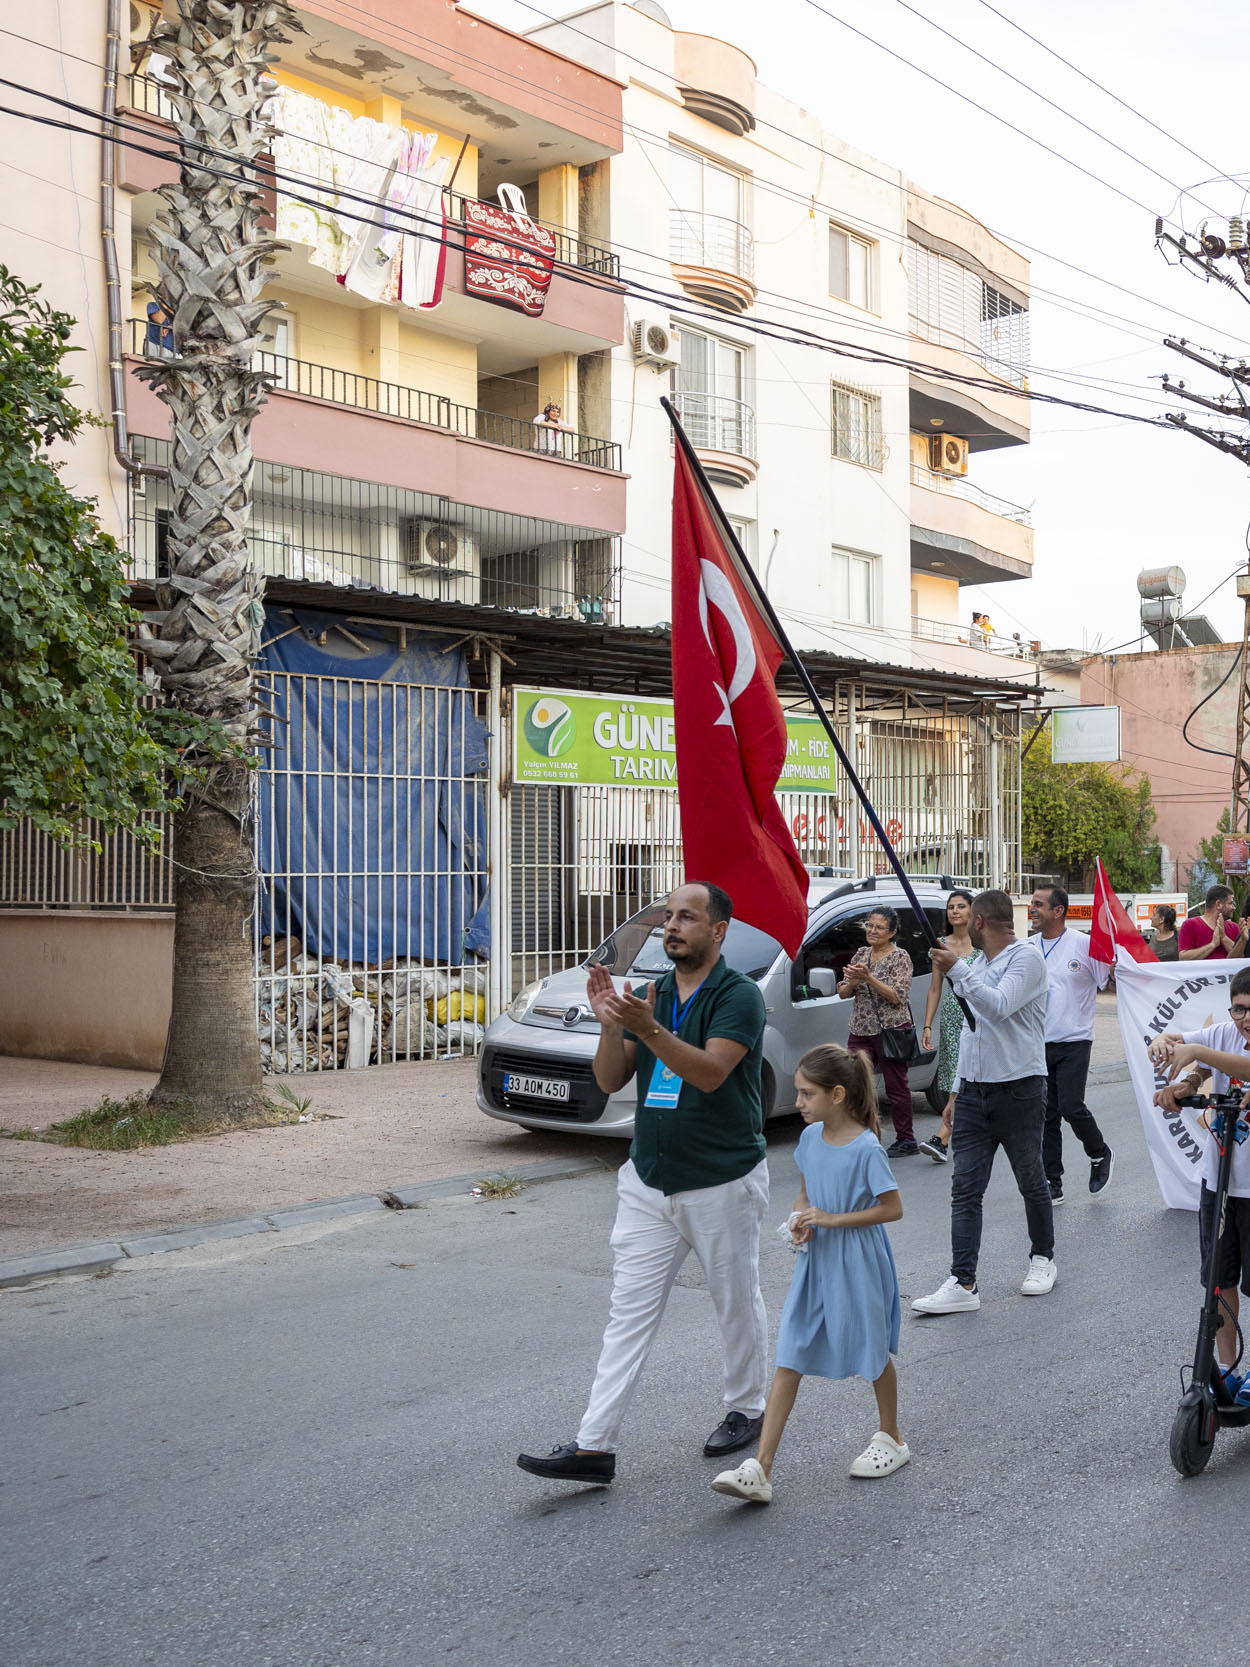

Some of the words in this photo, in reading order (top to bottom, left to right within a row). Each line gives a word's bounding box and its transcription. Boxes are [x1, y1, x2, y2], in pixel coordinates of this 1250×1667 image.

[593, 703, 677, 753] GÜNE
[808, 736, 830, 758] FİDE
[549, 761, 578, 770] YILMAZ
[610, 756, 679, 781] TARIM
[779, 760, 831, 780] KİPMANLARI
[1148, 976, 1215, 1034] KÜLTÜR
[508, 1076, 521, 1091] 33
[524, 1080, 543, 1095] AOM
[545, 1082, 566, 1098] 450
